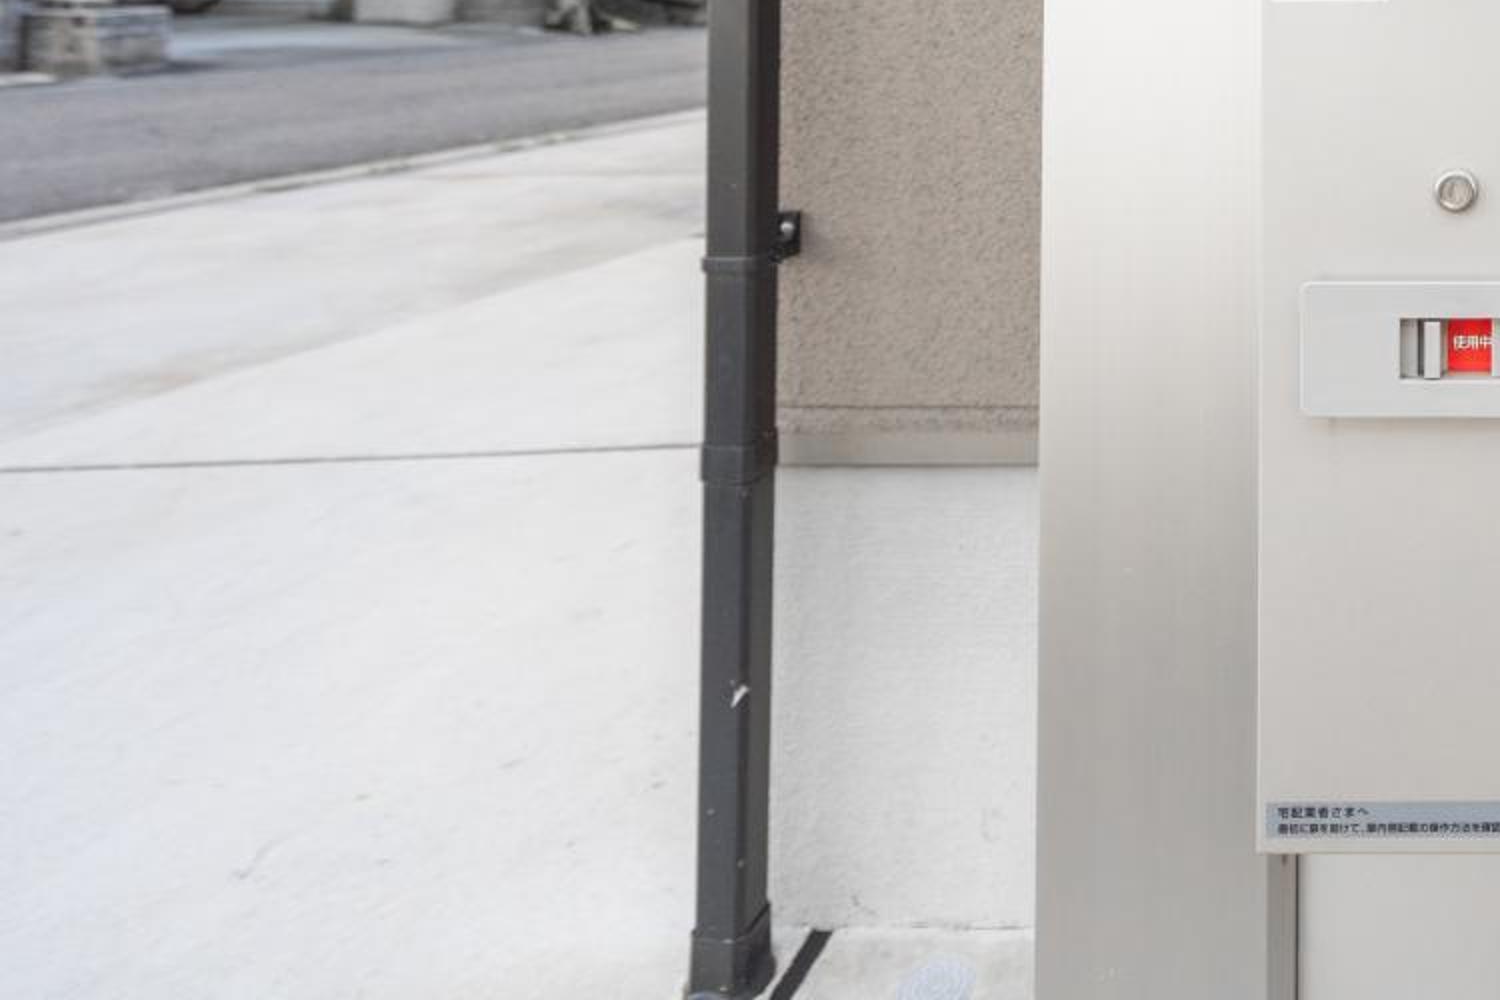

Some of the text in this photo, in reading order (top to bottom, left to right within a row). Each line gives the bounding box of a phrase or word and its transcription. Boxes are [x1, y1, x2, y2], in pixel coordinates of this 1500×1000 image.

[1277, 807, 1370, 819] 宅配業者さまへ
